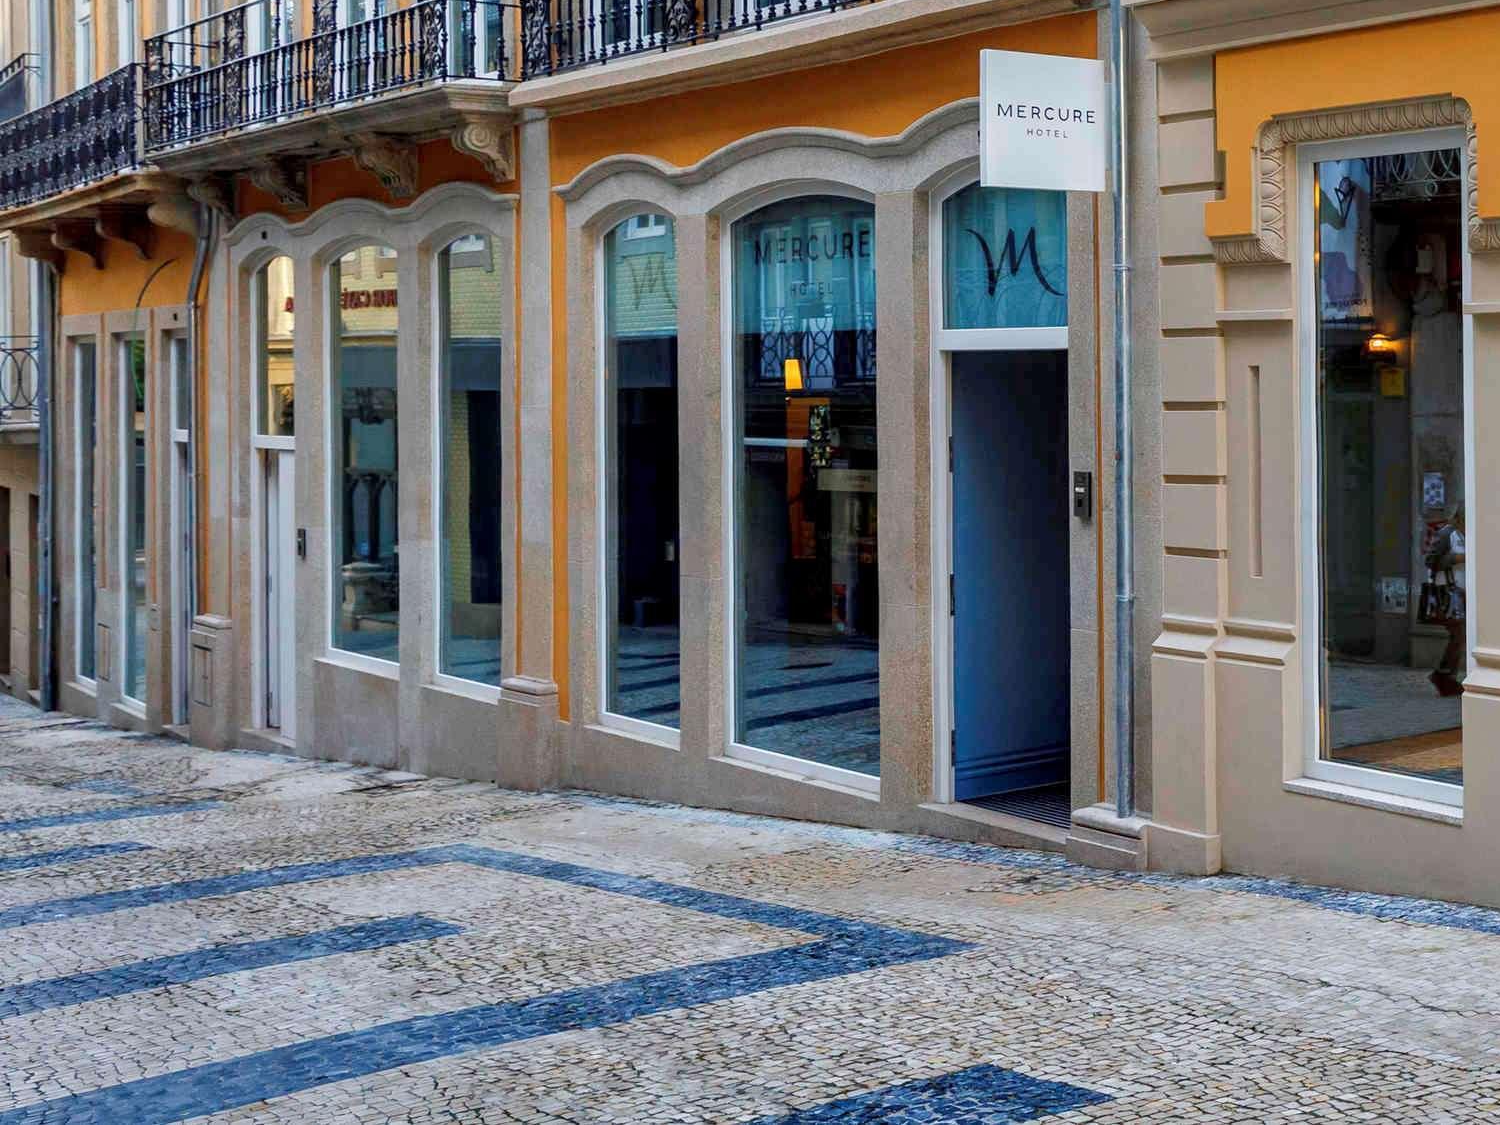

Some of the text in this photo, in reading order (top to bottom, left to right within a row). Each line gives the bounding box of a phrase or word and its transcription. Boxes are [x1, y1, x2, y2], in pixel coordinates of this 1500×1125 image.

[996, 103, 1096, 124] MERCURE
[1026, 128, 1068, 139] HOTEL
[754, 230, 871, 266] MERCURE
[790, 282, 832, 296] HOTEL
